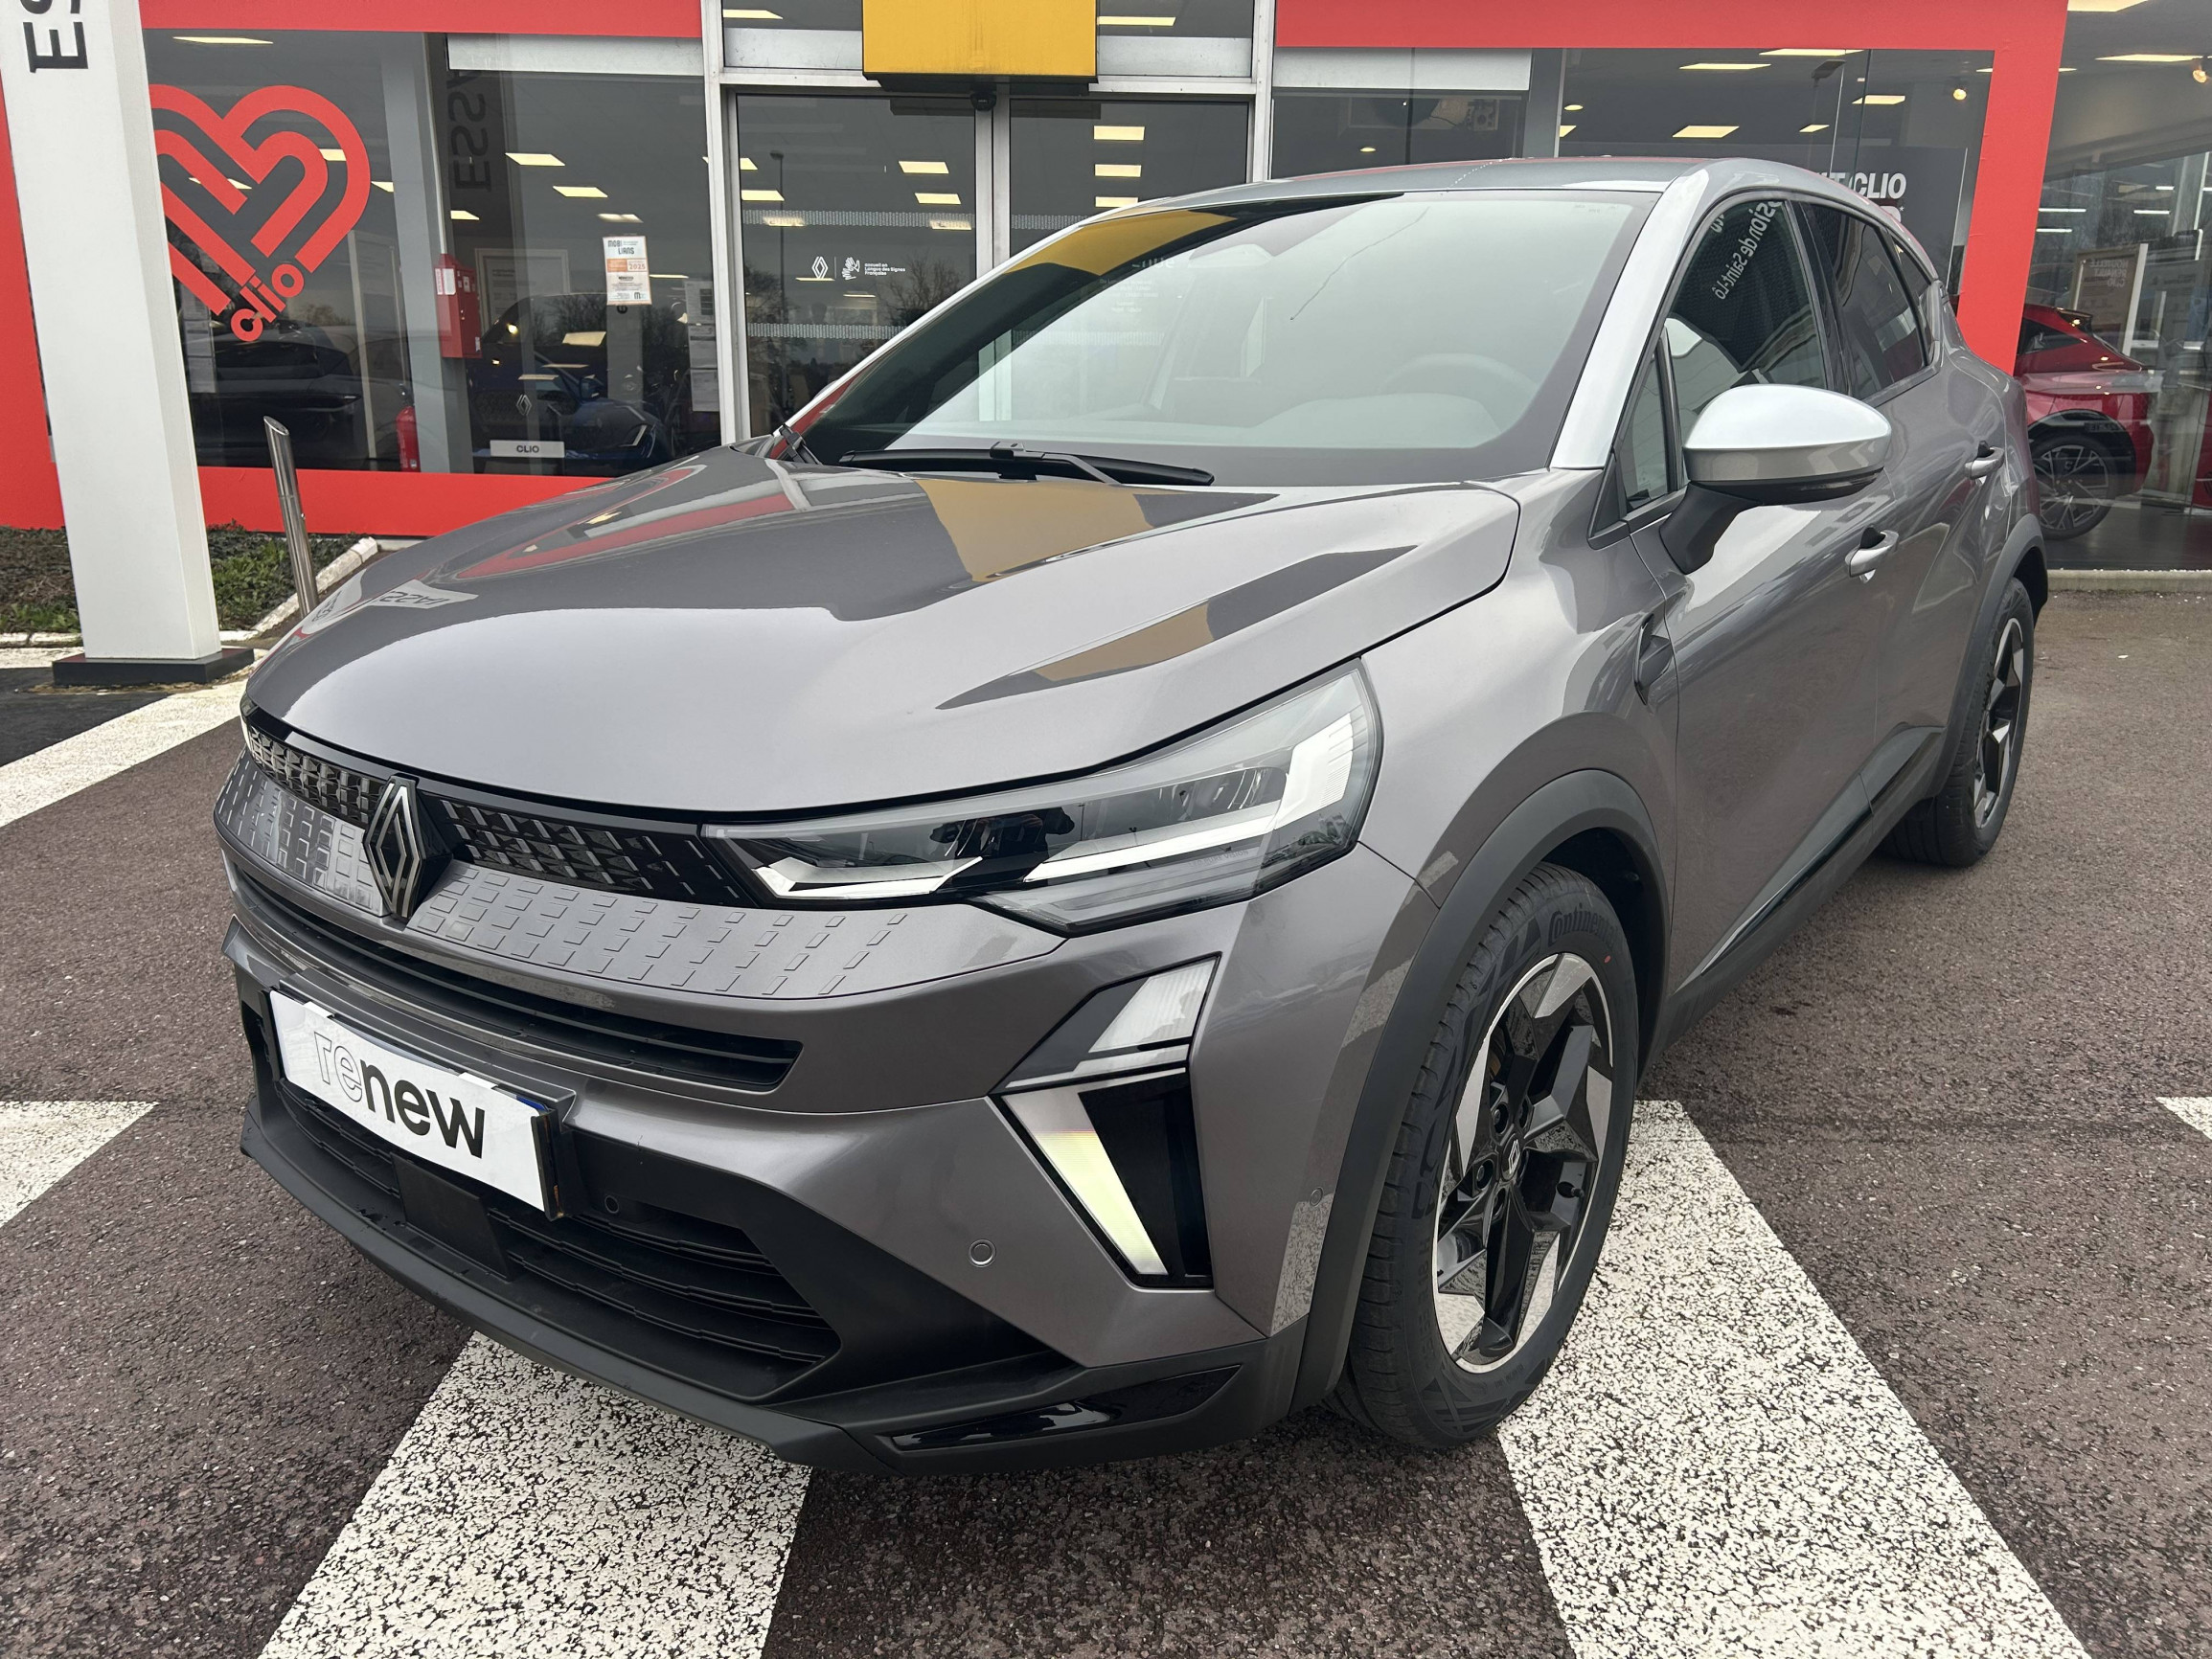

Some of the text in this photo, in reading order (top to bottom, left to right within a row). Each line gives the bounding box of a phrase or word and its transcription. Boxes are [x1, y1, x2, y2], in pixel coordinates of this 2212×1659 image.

[20, 0, 88, 73] E
[231, 263, 305, 342] clio
[314, 1031, 486, 1159] renew
